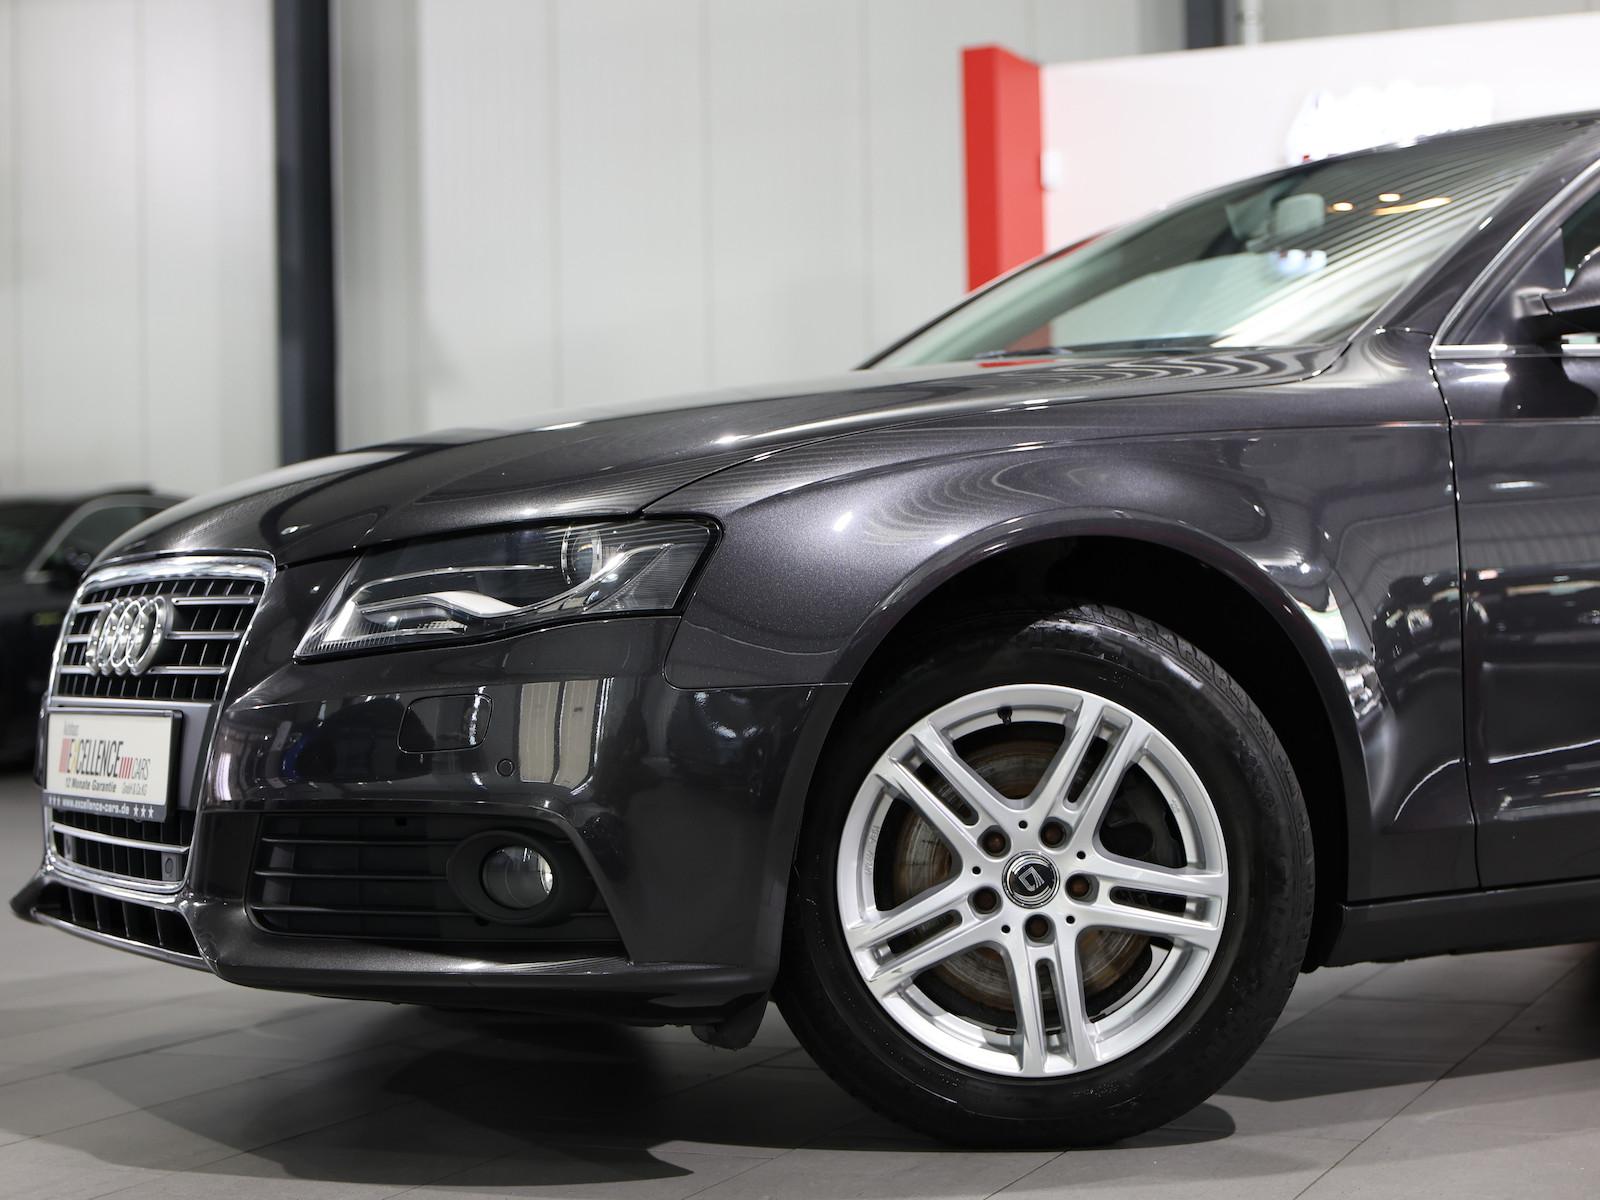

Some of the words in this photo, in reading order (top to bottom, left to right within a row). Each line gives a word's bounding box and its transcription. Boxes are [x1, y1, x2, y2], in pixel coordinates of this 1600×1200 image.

[131, 758, 151, 780] CARS
[72, 779, 91, 791] Monate
[91, 780, 117, 793] Garantie
[62, 798, 130, 815] www.excellence-cars.de
